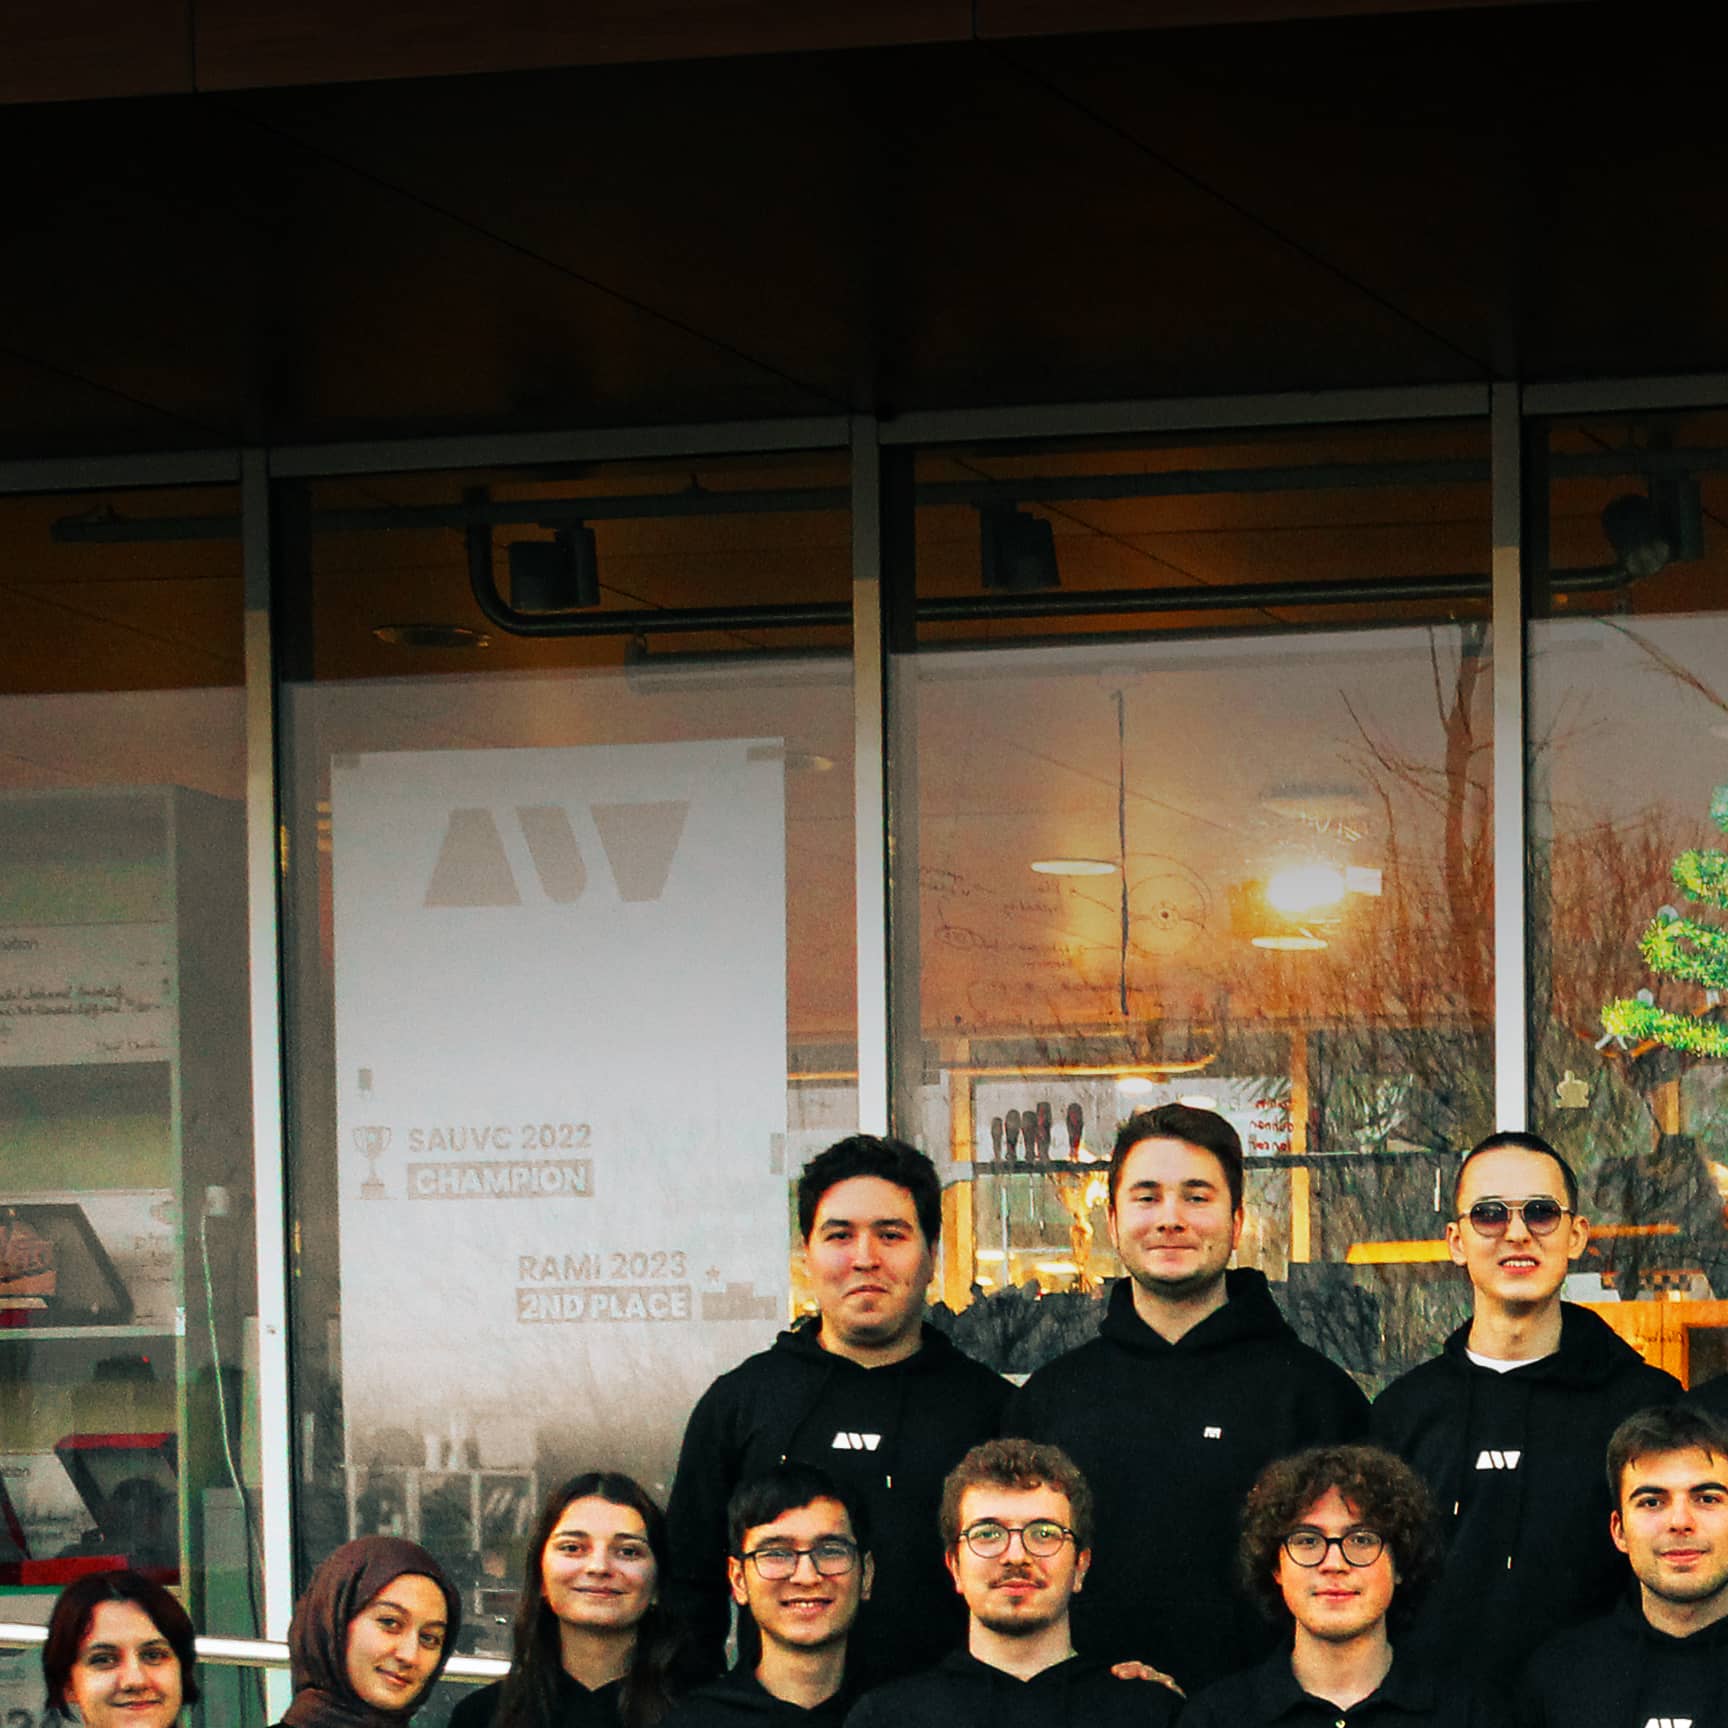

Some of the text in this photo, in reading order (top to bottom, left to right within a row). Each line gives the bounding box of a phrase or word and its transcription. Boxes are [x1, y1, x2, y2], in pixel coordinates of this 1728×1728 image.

[408, 1123, 592, 1152] SAUVC 2022
[415, 1165, 588, 1194] CHAMPION
[518, 1250, 689, 1281] RAMI 2023
[520, 1291, 688, 1320] 2ND PLACE
